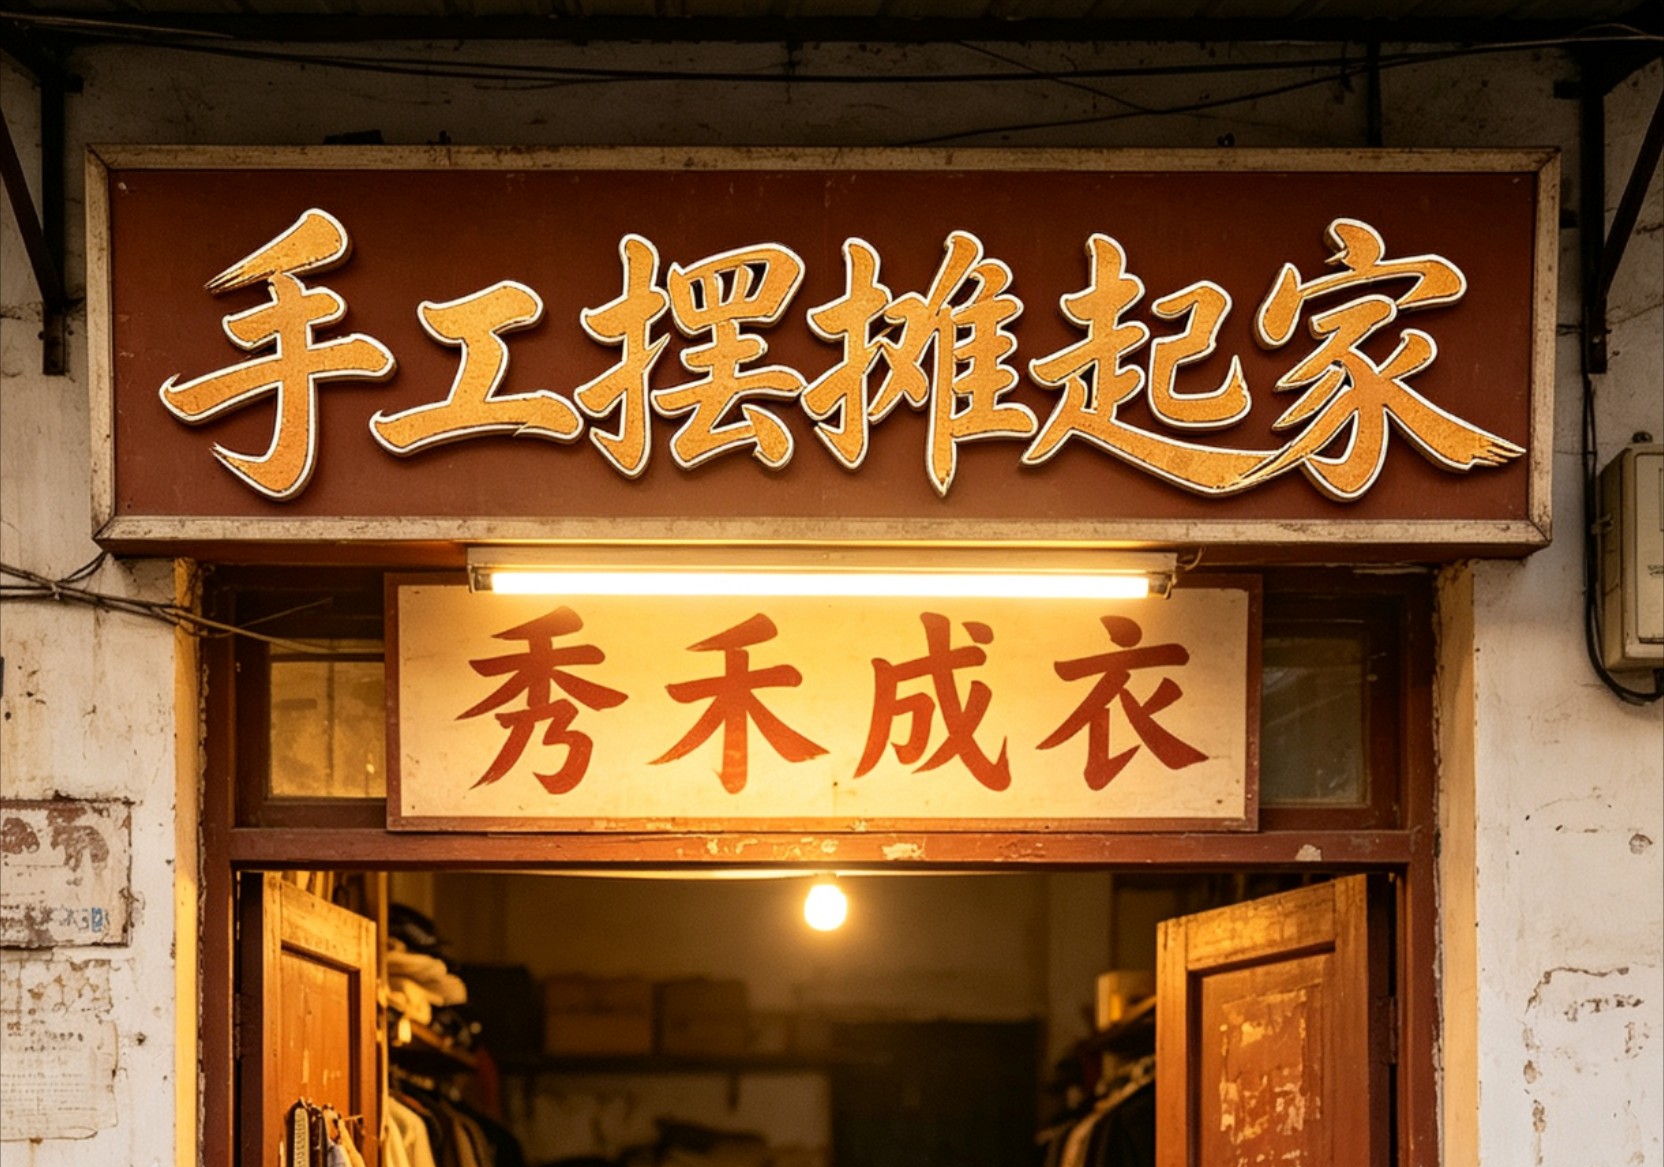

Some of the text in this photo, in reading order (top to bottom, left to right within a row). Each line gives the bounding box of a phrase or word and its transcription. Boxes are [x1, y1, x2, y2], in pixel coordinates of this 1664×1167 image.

[158, 206, 1526, 502] 手工摆摊起家
[455, 606, 1210, 799] 秀禾成衣
